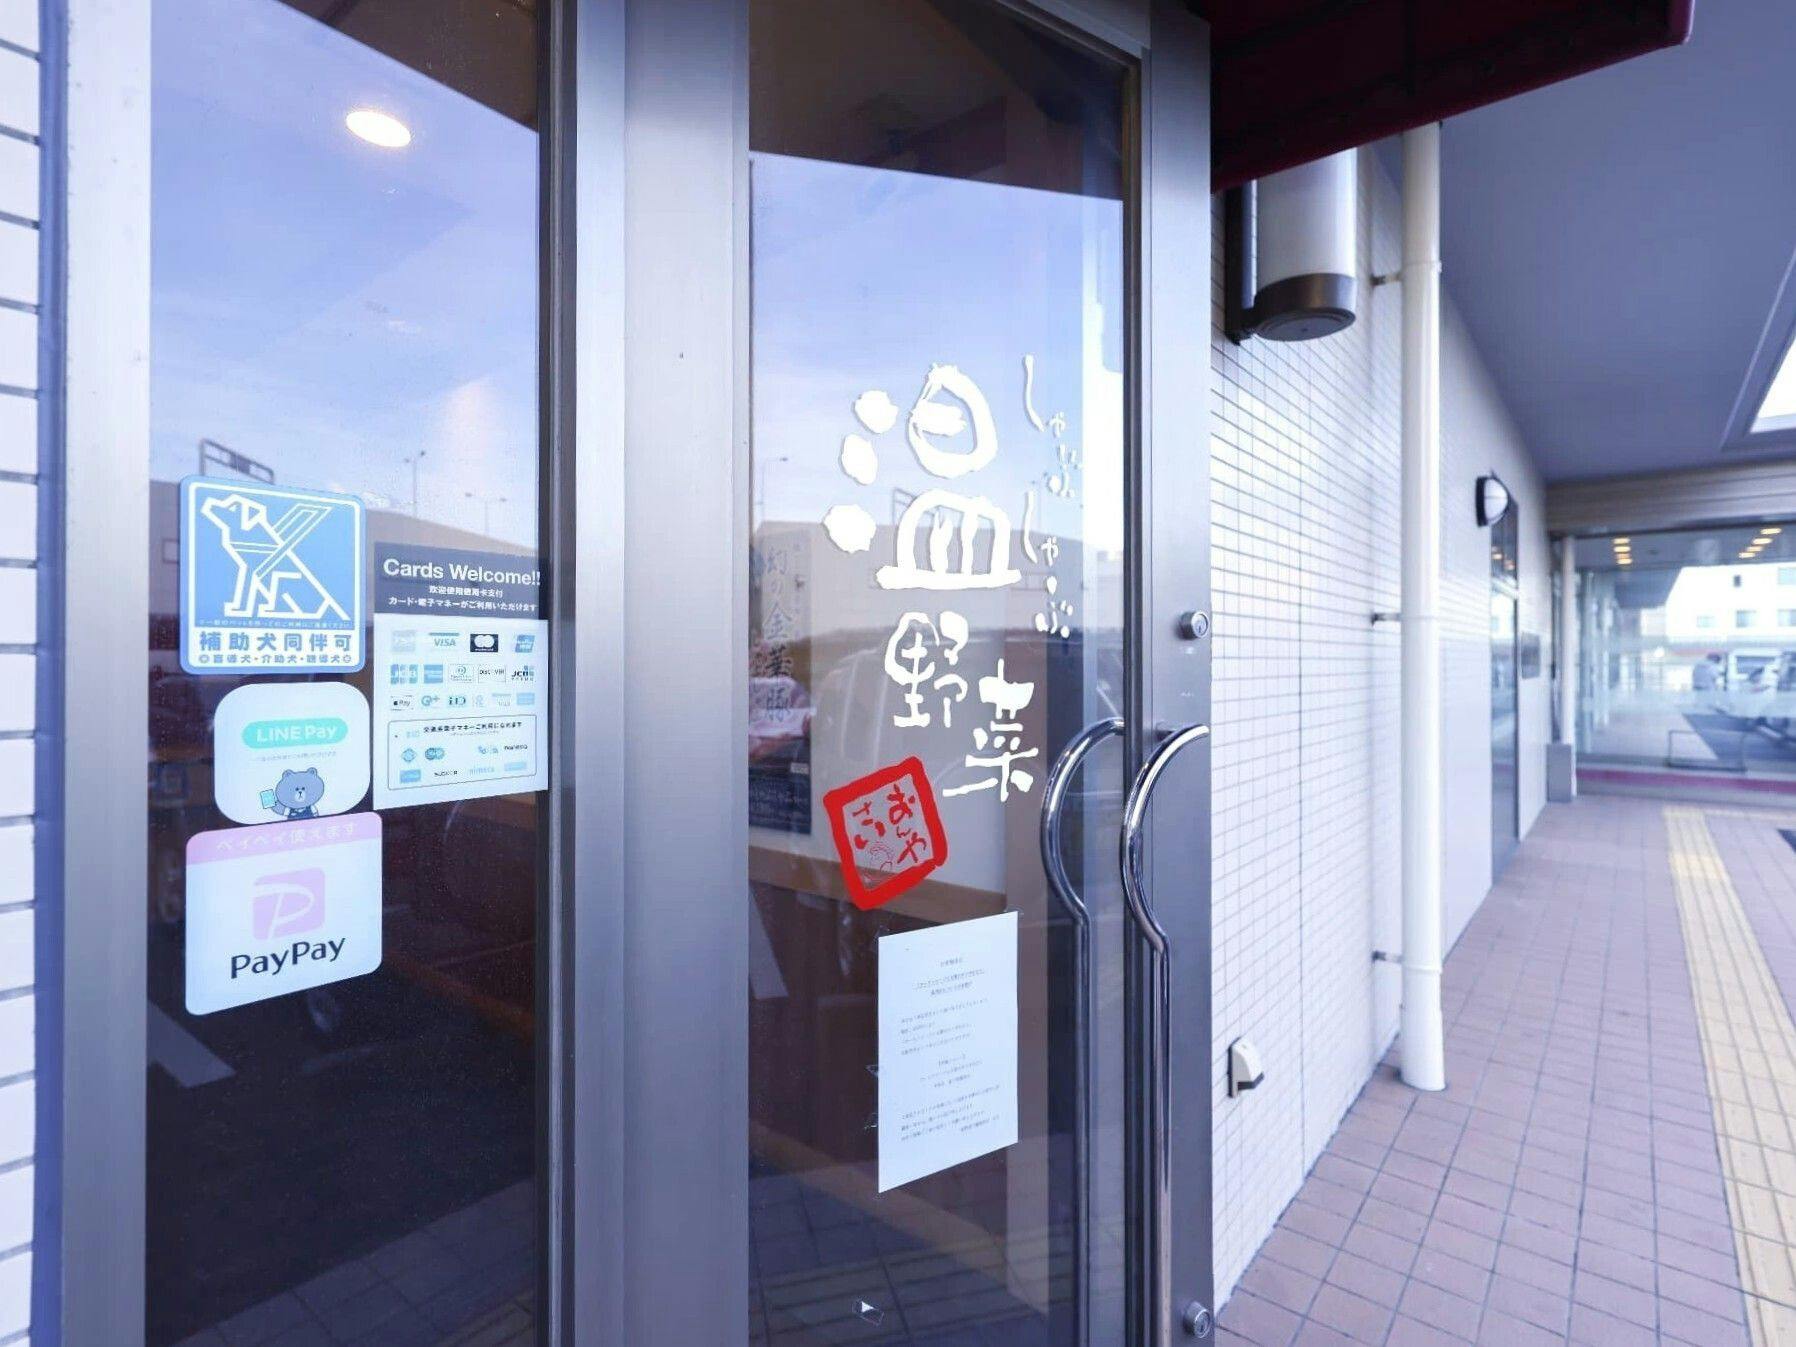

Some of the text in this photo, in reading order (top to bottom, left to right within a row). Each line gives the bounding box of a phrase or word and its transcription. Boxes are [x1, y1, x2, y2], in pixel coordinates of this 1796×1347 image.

[383, 558, 541, 586] Cards Welcome!!
[822, 362, 1039, 802] 温野菜
[200, 631, 352, 651] 補助犬同伴可
[434, 637, 457, 647] VISA
[256, 724, 338, 742] LINE Pay
[230, 937, 347, 979] PayPay
